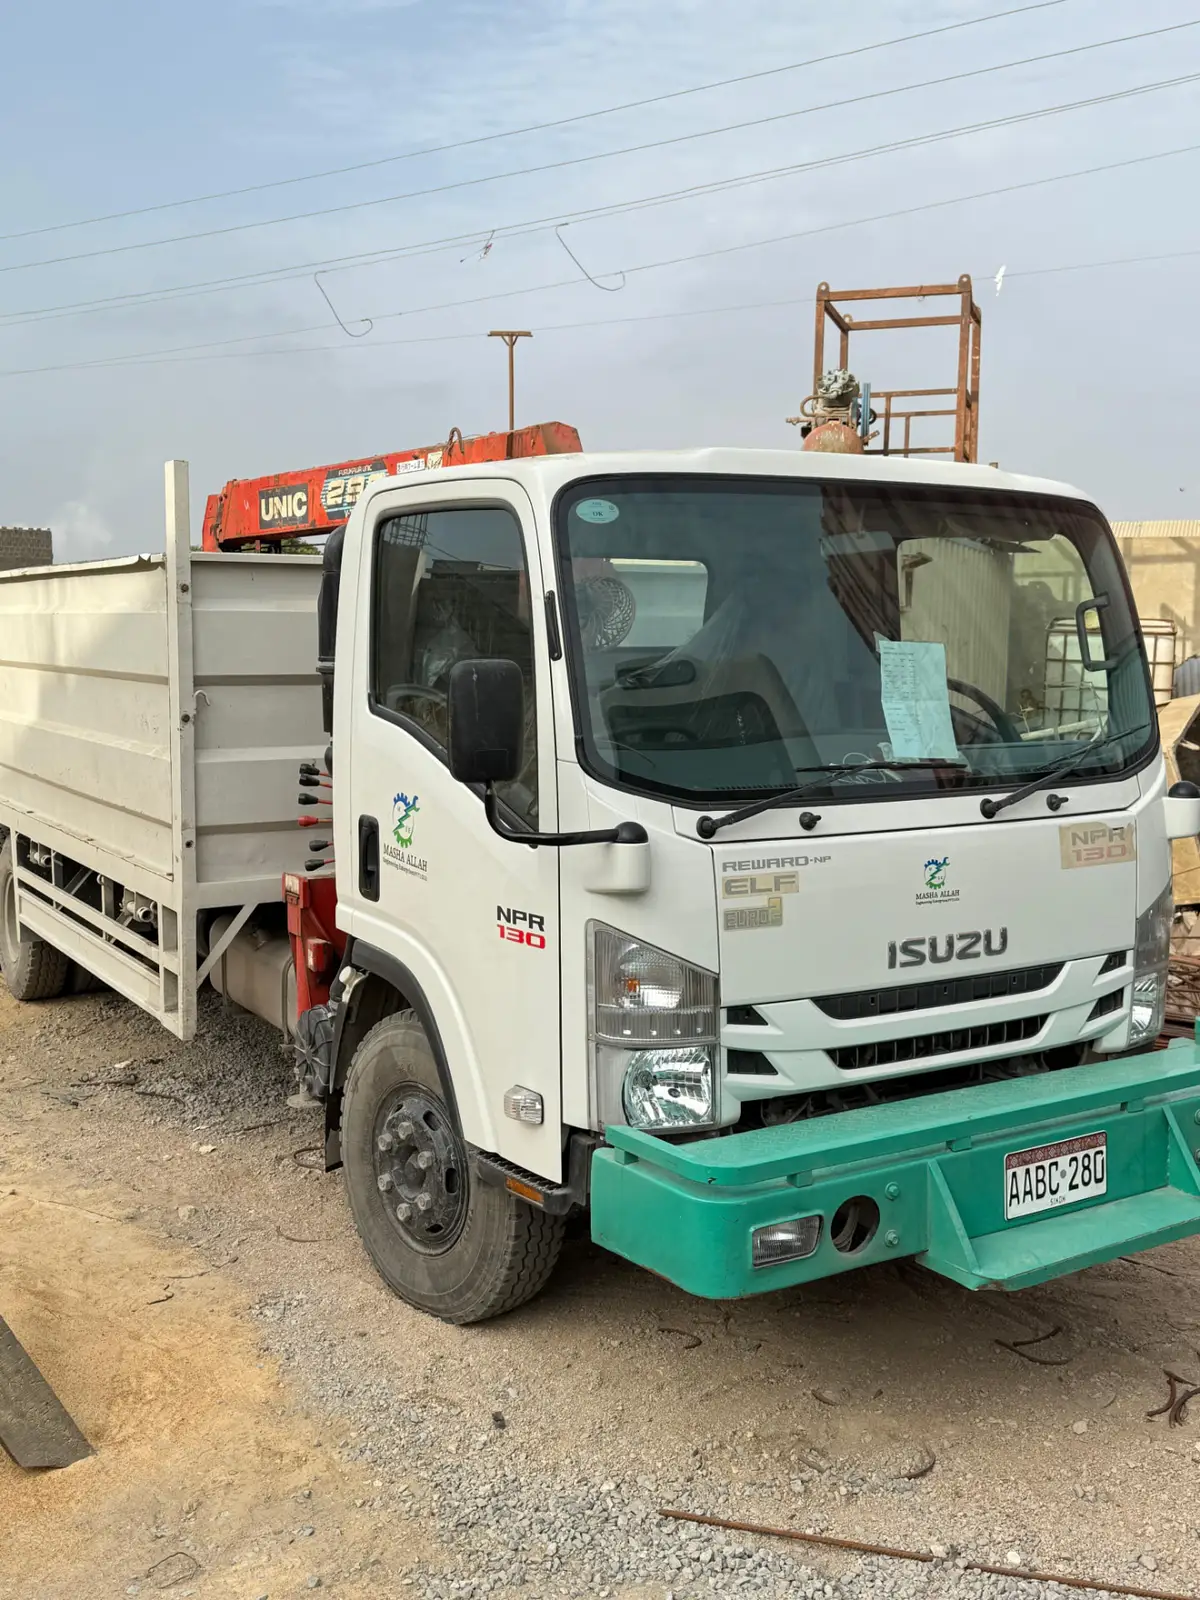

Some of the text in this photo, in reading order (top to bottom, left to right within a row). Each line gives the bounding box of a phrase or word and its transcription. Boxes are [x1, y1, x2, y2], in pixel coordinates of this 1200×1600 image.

[260, 491, 307, 521] UNIC
[1071, 827, 1126, 846] NPR
[383, 842, 428, 872] MASHA ALLAH
[1071, 844, 1126, 862] 130
[724, 874, 796, 896] ELF
[940, 889, 960, 897] ALLAH
[497, 905, 545, 932] NPR
[497, 923, 546, 949] 130
[887, 926, 1008, 970] ISUZU
[1009, 1150, 1104, 1207] AABC 280
